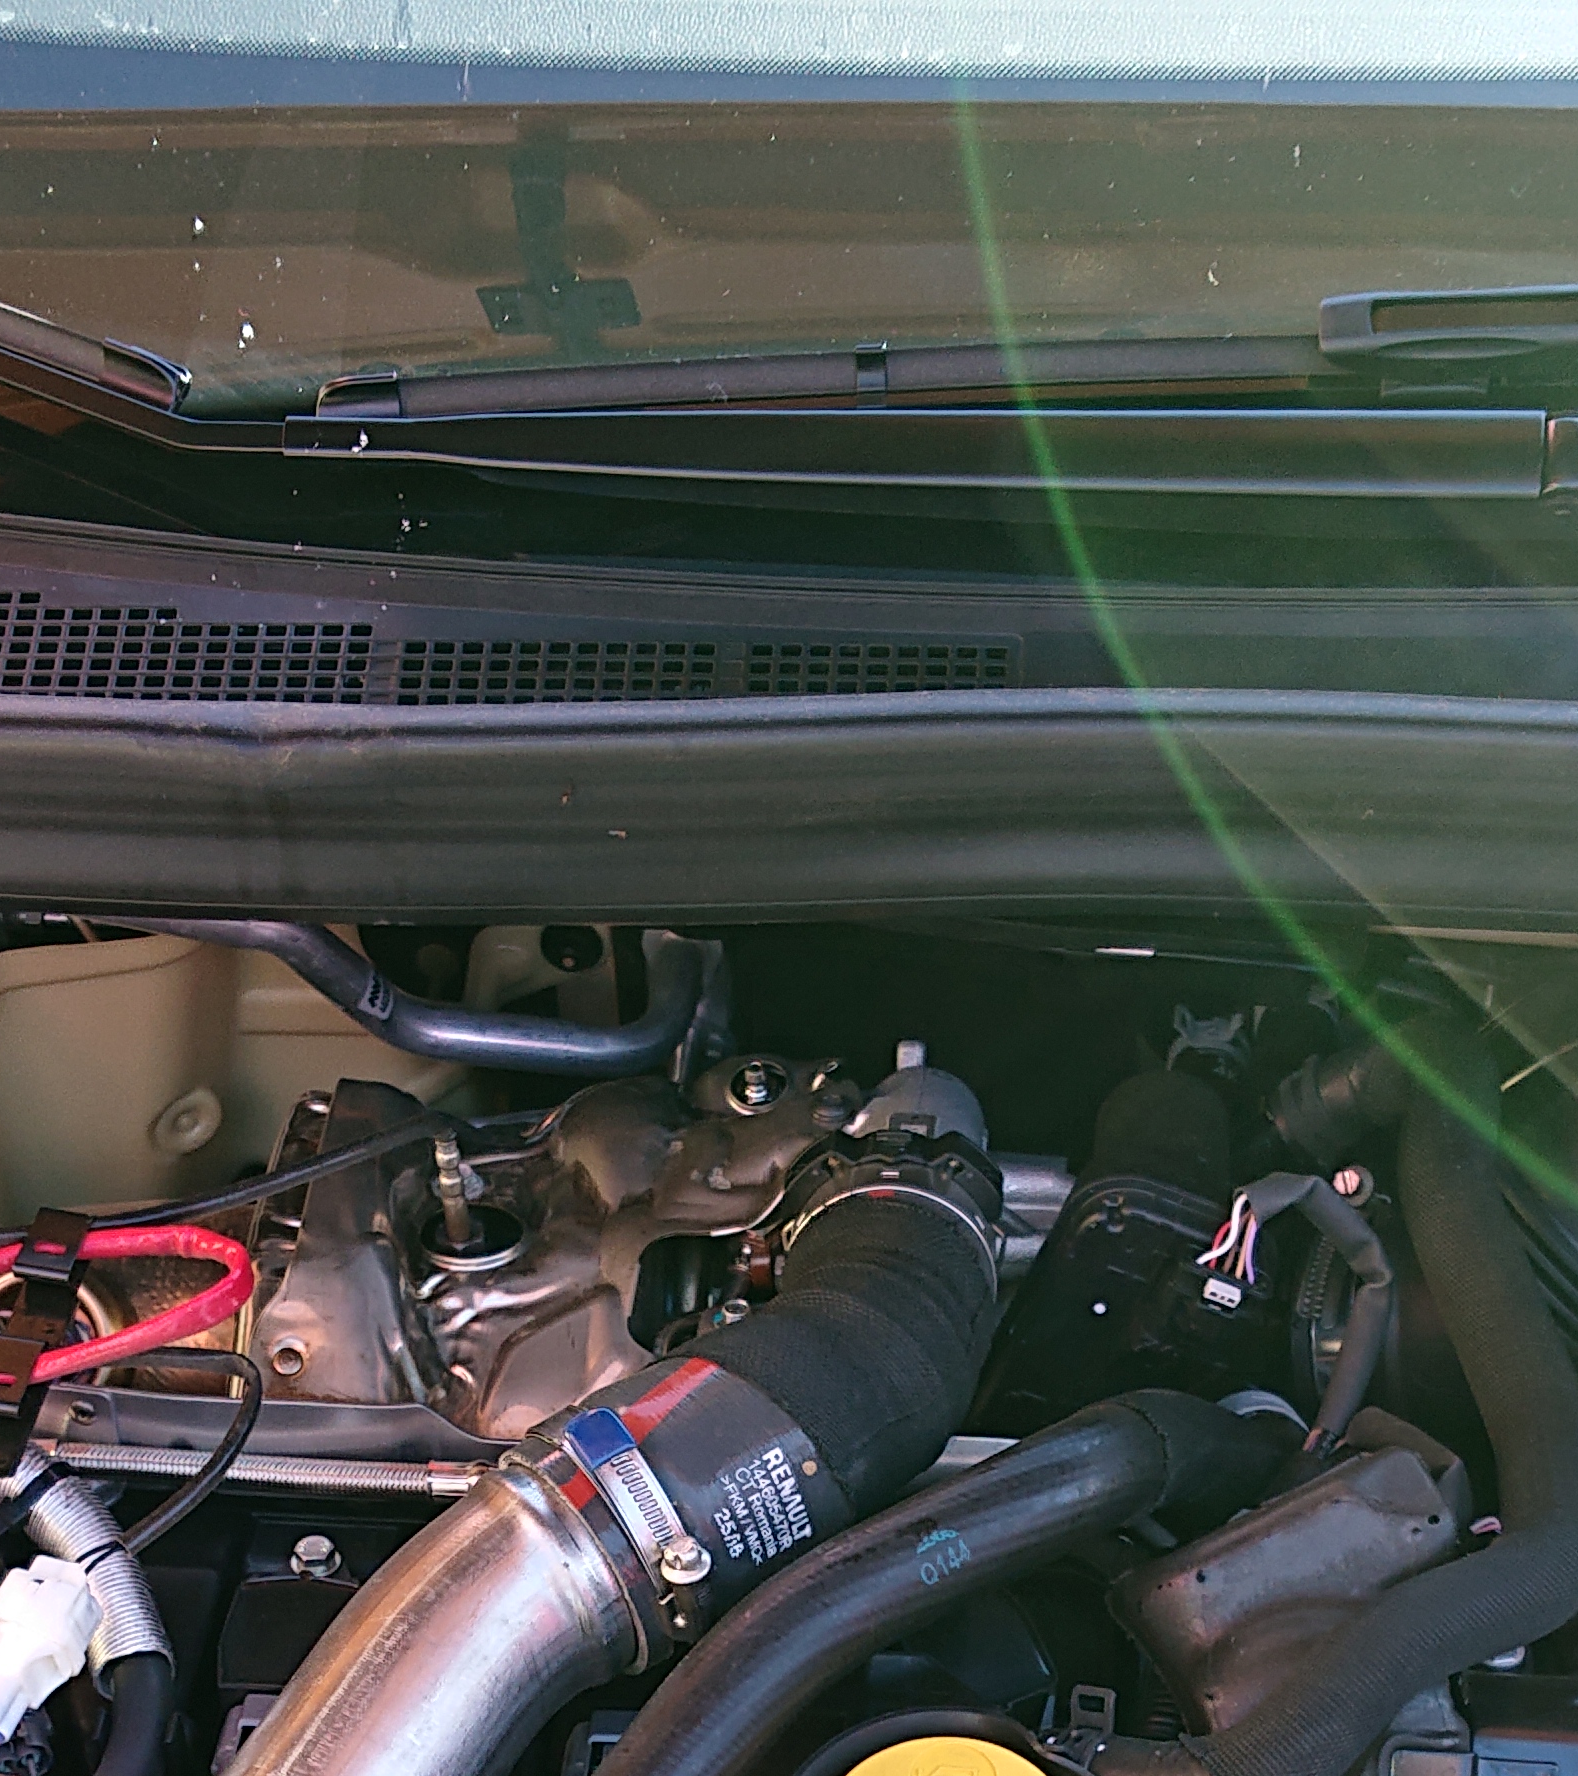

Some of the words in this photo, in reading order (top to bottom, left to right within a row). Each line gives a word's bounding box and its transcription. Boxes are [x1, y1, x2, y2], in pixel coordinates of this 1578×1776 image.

[734, 1466, 762, 1491] CT
[748, 1491, 778, 1560] Romania
[760, 1447, 813, 1541] RENAULT
